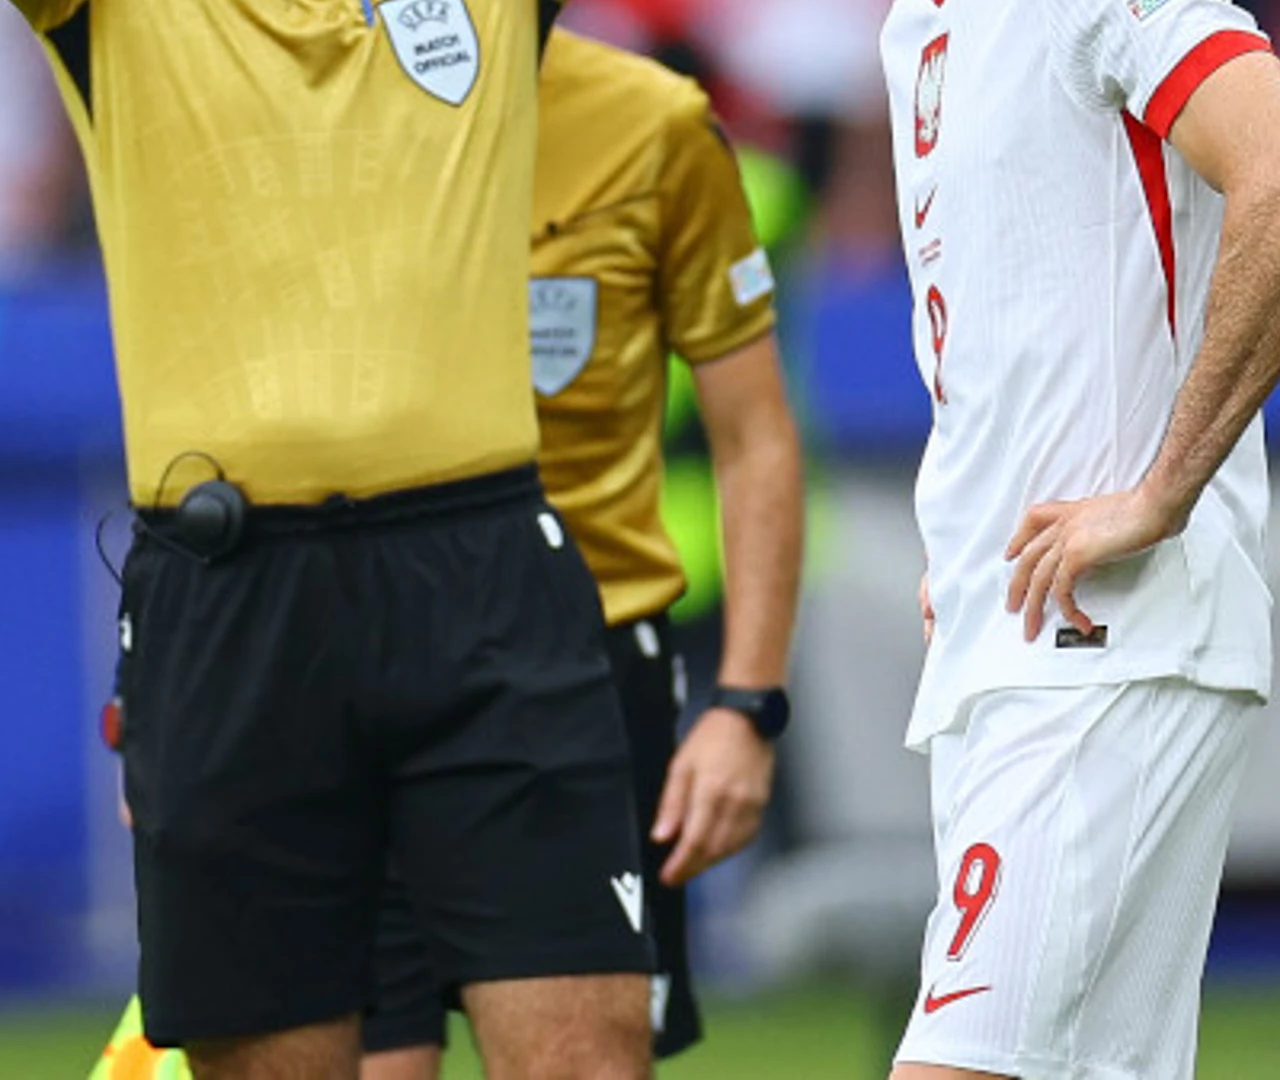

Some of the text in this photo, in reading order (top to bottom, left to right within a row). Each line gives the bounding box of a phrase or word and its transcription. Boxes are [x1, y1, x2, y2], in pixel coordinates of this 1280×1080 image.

[414, 33, 460, 56] MATCH
[414, 50, 470, 75] OFFICIAL
[947, 842, 1002, 962] 9
